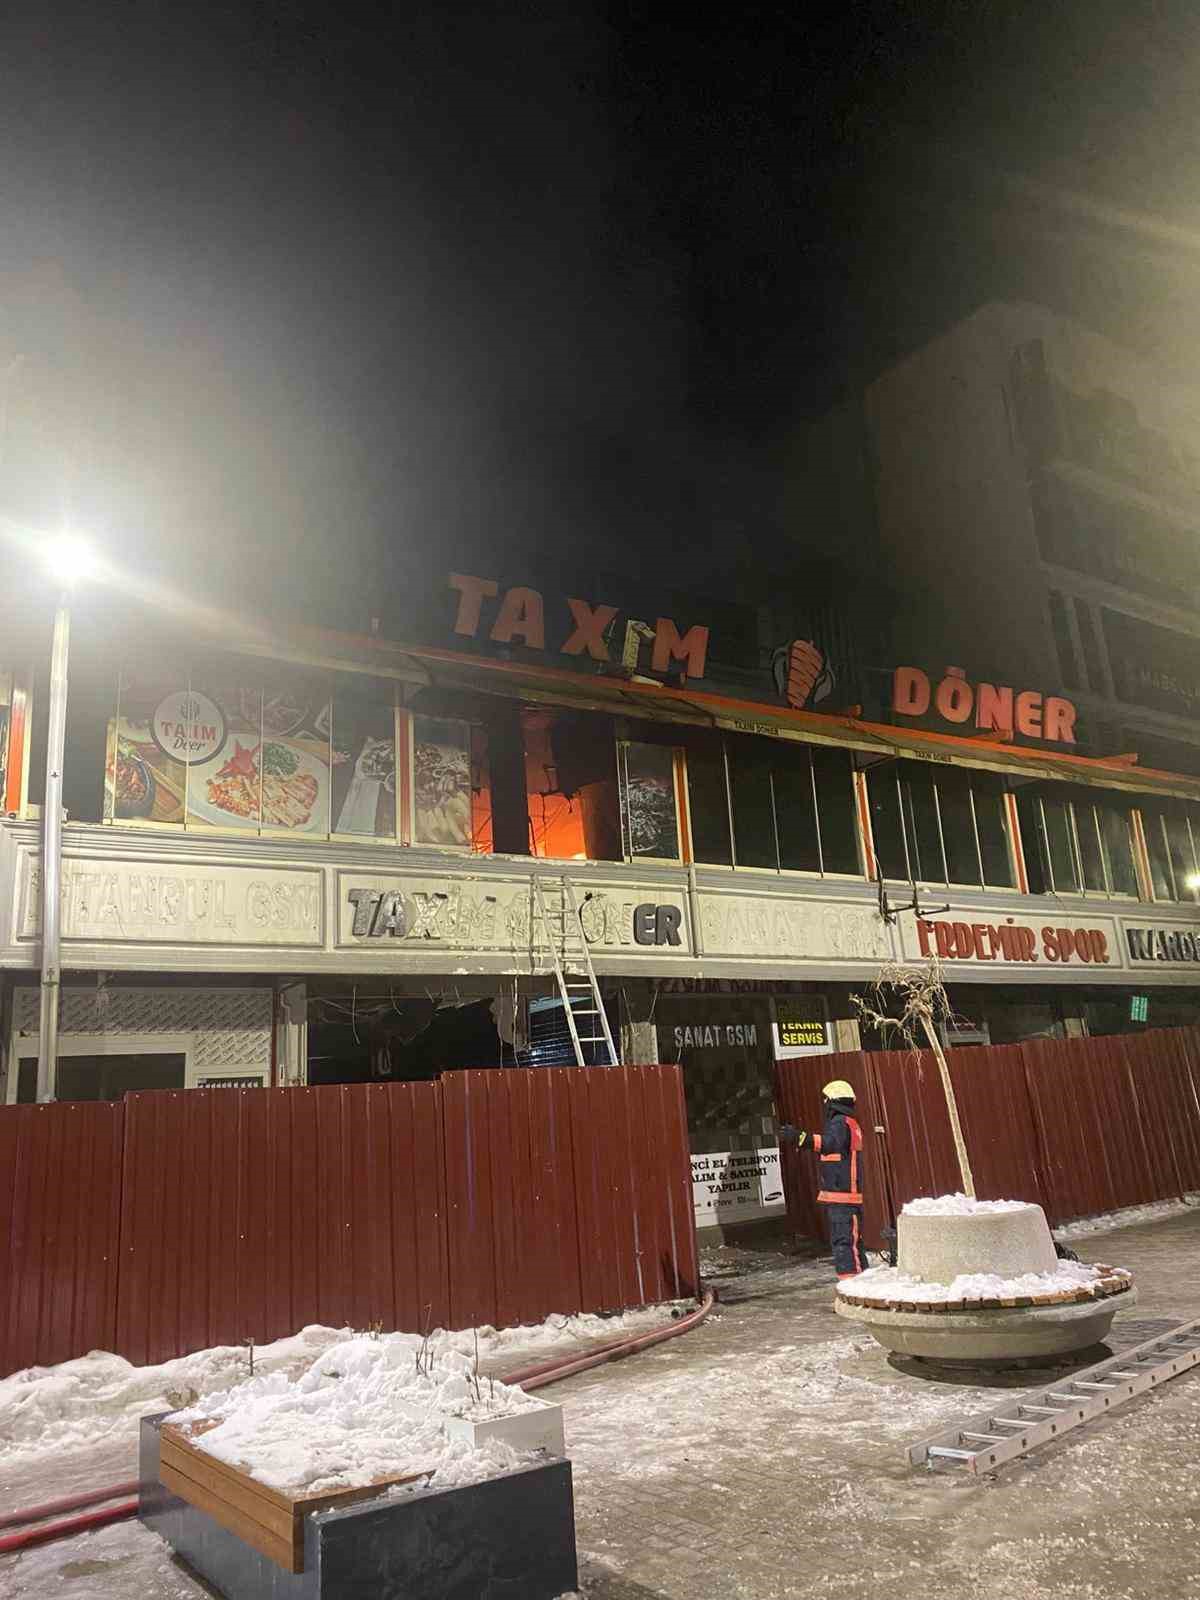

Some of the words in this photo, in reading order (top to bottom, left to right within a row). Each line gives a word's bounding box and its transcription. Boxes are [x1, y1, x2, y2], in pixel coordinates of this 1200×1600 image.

[893, 665, 1077, 745] DÖNER
[1041, 926, 1110, 964] SPOR
[674, 1025, 721, 1049] SANAT
[725, 1023, 758, 1047] GSM
[712, 1159, 728, 1169] EL
[730, 1167, 768, 1181] SATIMI
[708, 1181, 752, 1194] YAPILIR
